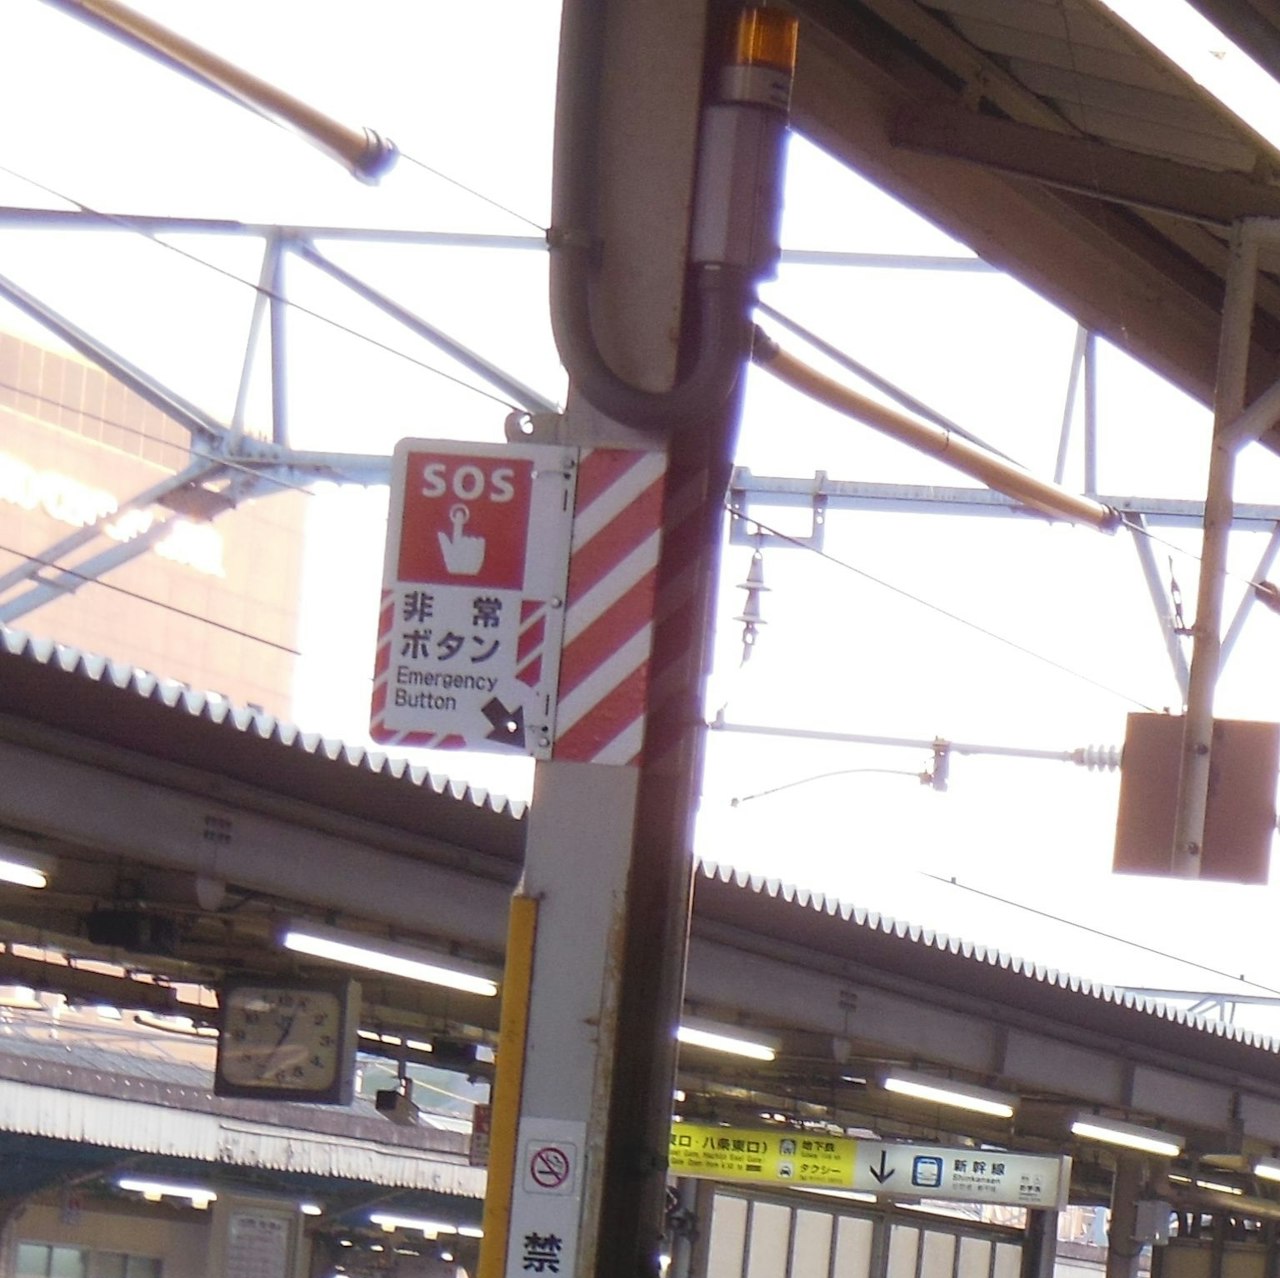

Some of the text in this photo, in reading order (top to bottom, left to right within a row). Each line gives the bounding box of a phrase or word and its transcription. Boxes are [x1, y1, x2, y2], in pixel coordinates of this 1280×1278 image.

[421, 463, 516, 503] SOS
[402, 590, 503, 630] 非常
[400, 630, 500, 664] ボタン
[396, 666, 498, 692] Emergency
[394, 689, 457, 711] Button
[799, 1163, 842, 1176] タクシー
[953, 1159, 1006, 1176] 新幹線
